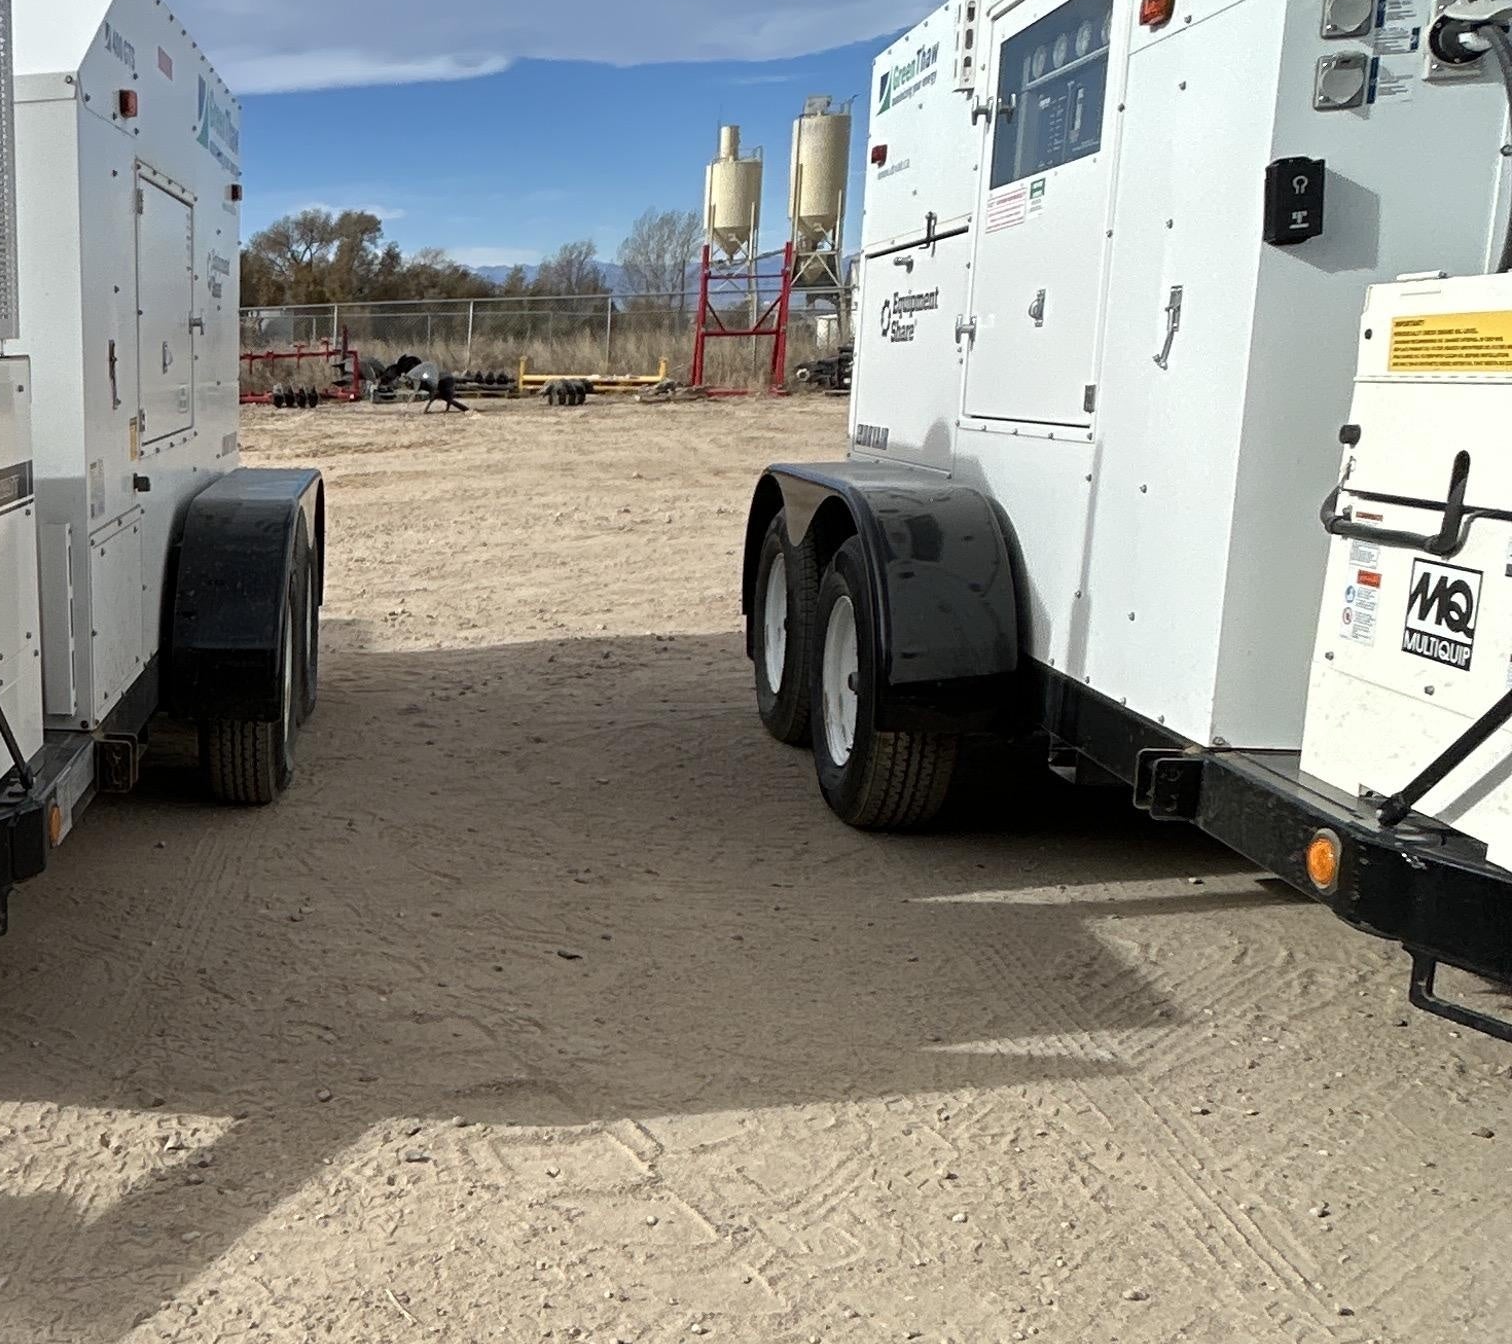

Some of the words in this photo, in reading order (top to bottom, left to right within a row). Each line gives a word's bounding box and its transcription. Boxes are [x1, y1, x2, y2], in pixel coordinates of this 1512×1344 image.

[892, 286, 939, 318] Equipment
[890, 319, 915, 343] Share
[1407, 571, 1475, 639] MQ
[1403, 629, 1471, 667] MULTIQUIP
